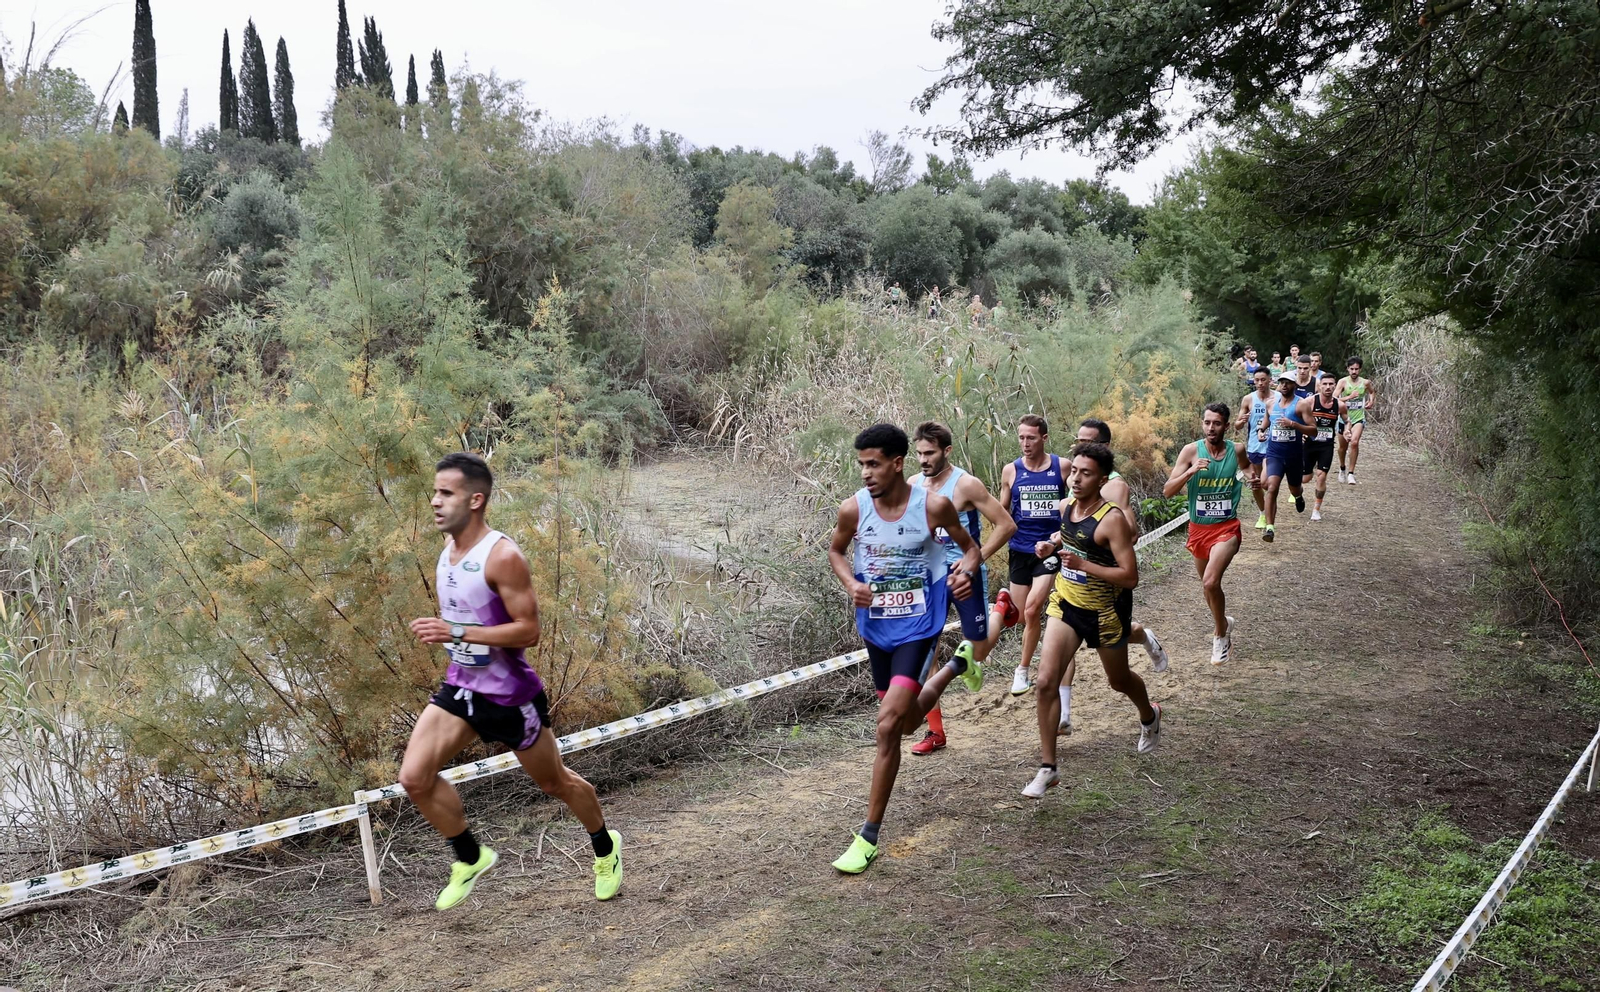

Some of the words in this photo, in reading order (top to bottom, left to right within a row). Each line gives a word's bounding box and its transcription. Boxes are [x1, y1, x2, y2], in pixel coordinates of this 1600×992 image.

[1027, 501, 1054, 510] 1946
[1204, 501, 1224, 510] 821
[878, 591, 915, 607] 3309
